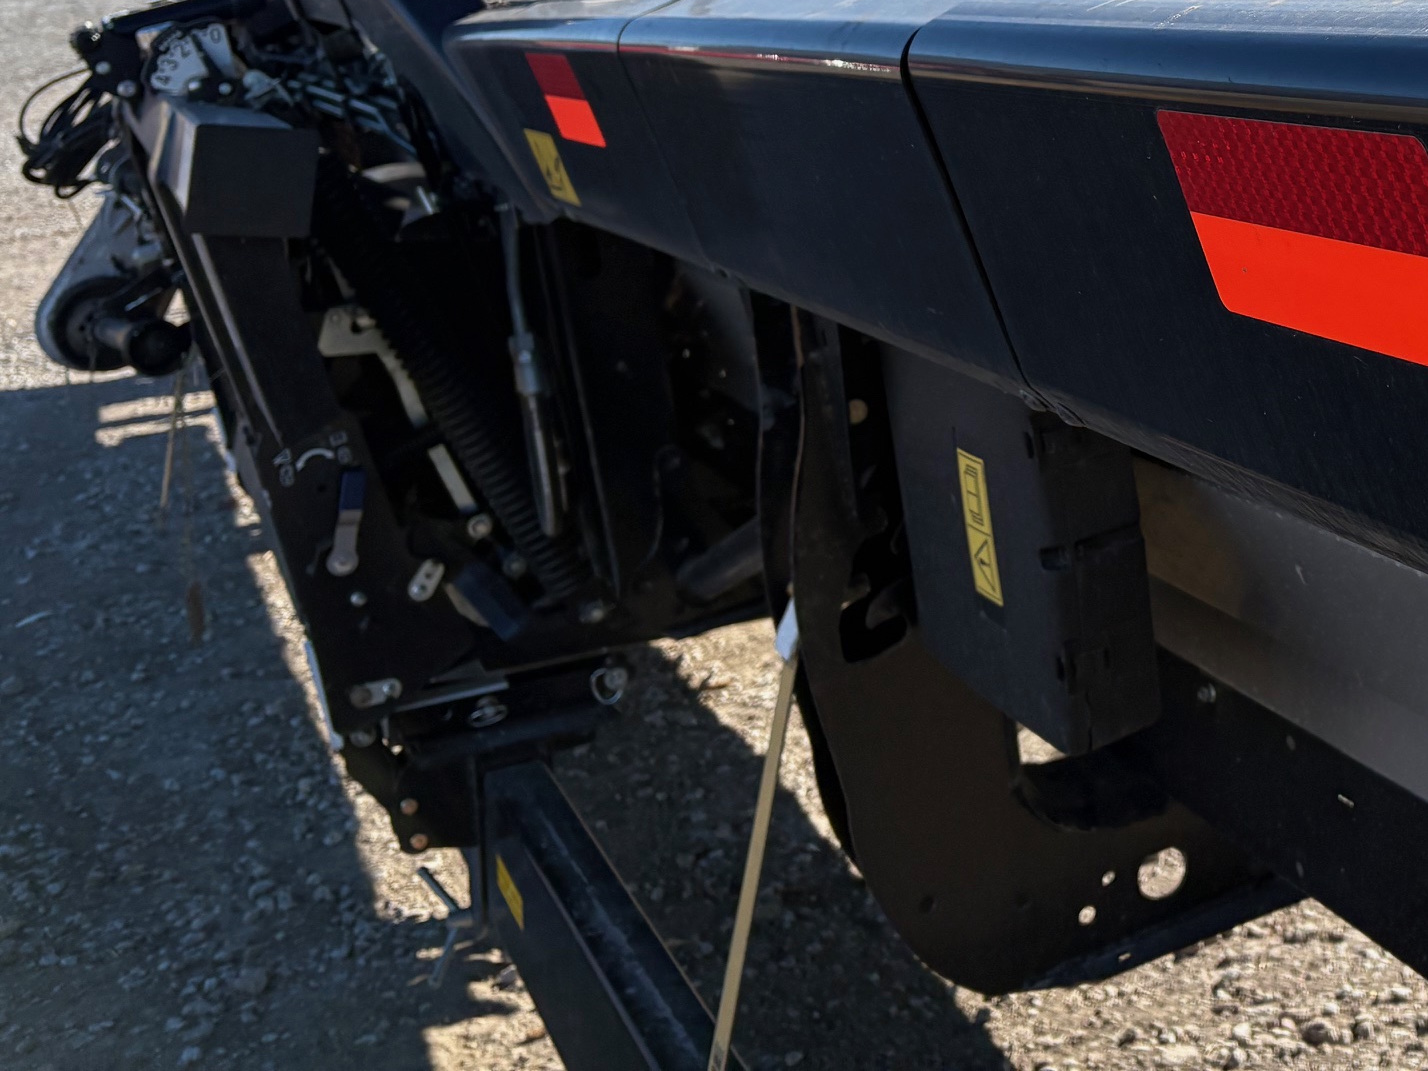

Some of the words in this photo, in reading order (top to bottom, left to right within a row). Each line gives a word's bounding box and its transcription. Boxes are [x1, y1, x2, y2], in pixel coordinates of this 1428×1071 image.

[160, 58, 179, 71] 3
[173, 42, 191, 59] 2
[210, 28, 222, 44] 0
